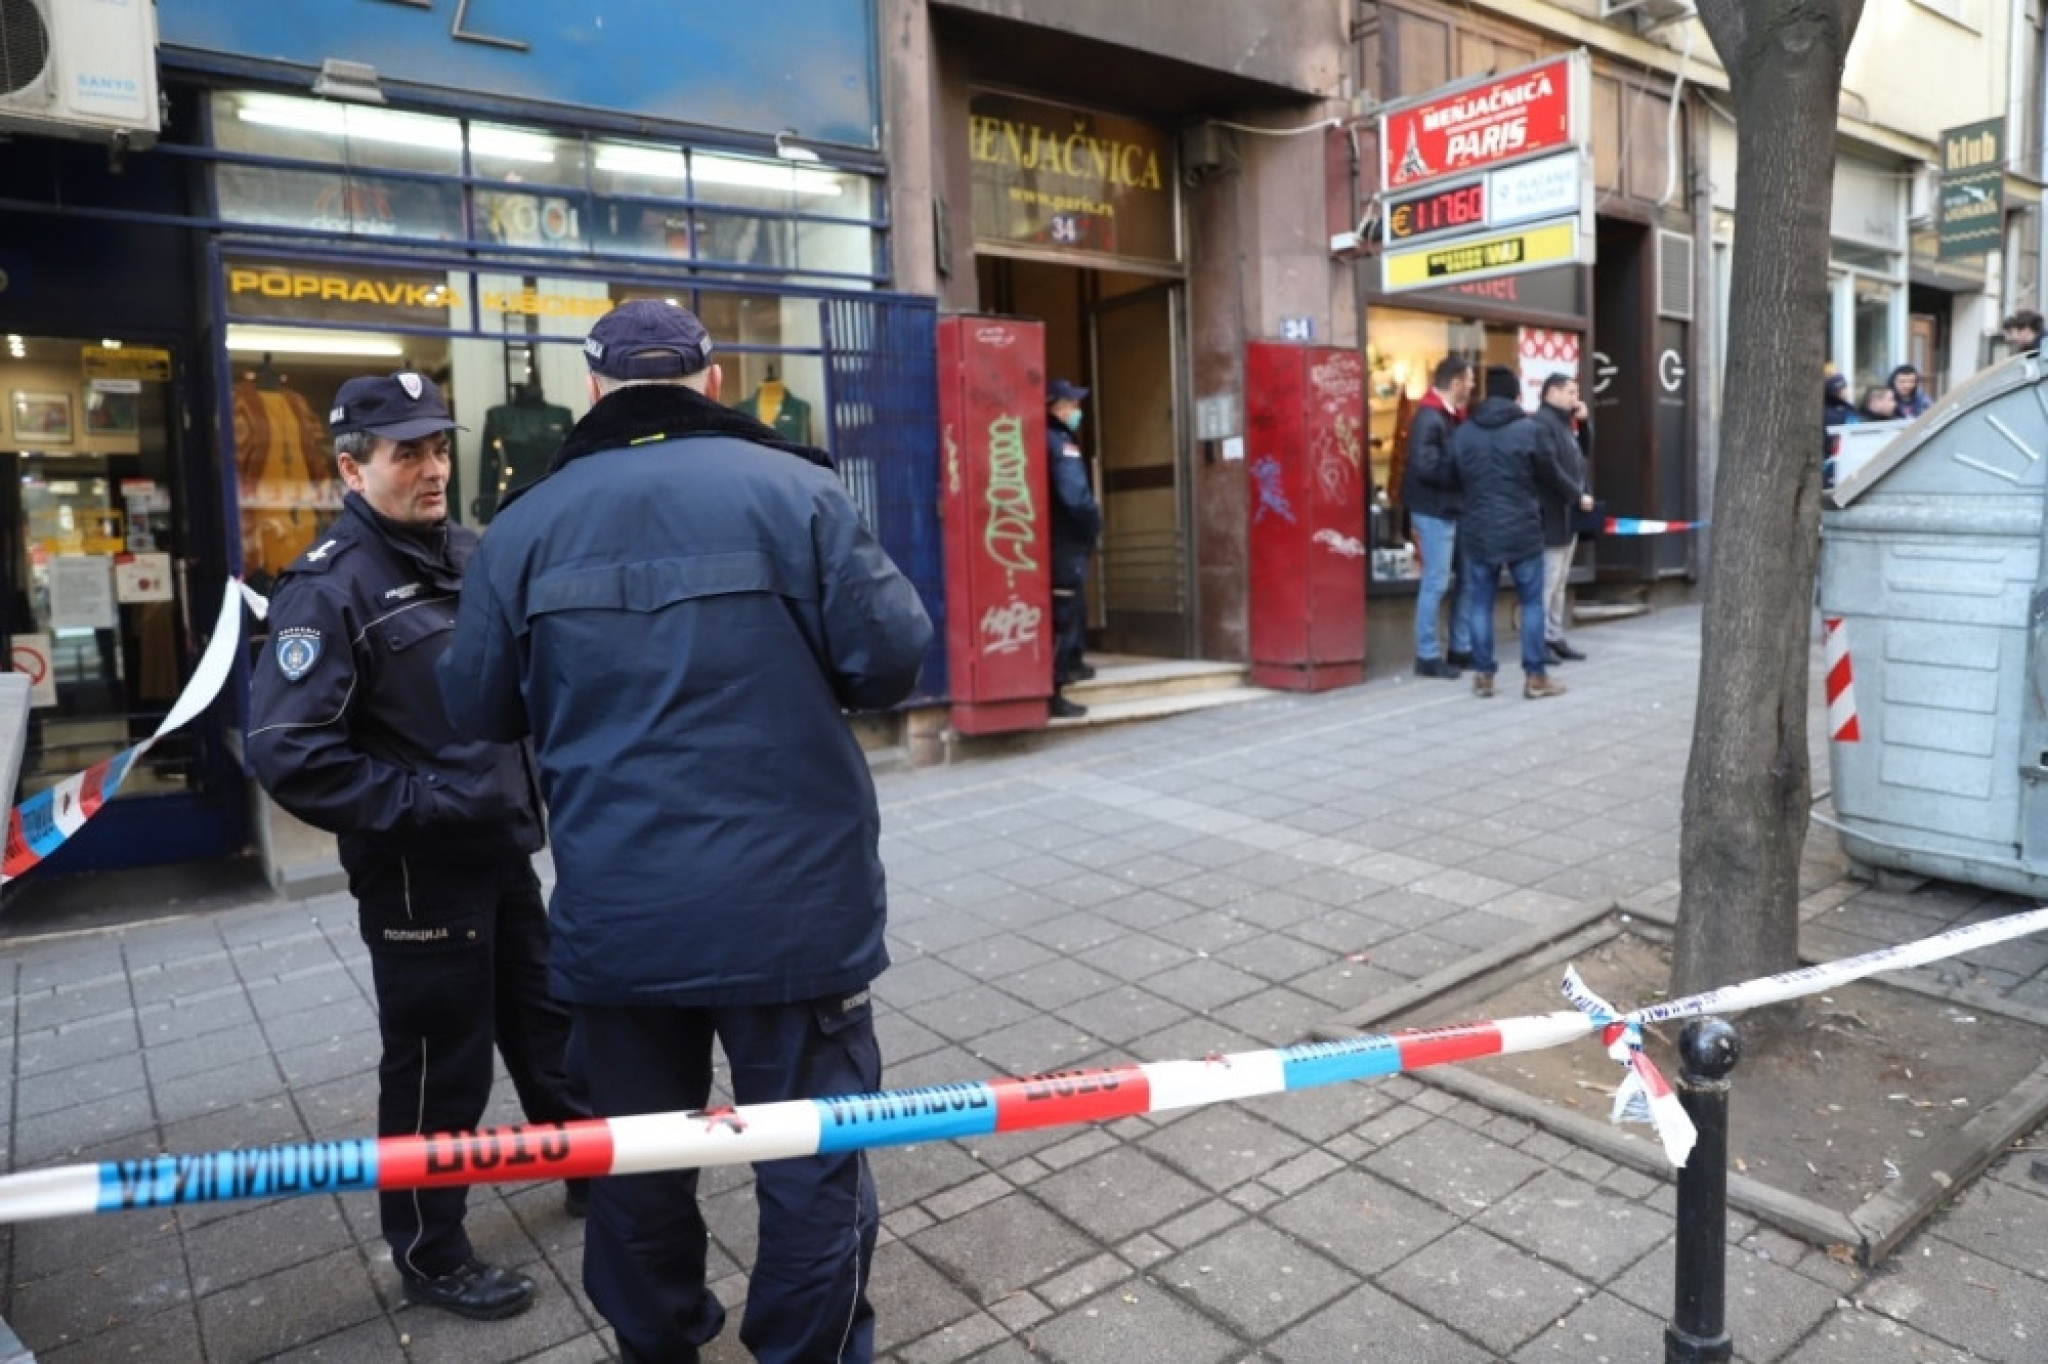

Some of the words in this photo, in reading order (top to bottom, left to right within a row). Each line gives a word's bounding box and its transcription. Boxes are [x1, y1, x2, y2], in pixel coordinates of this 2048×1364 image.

[1423, 76, 1553, 132] MENJAČNICA
[1445, 115, 1528, 166] PARIS
[229, 269, 462, 309] POPRAVKA
